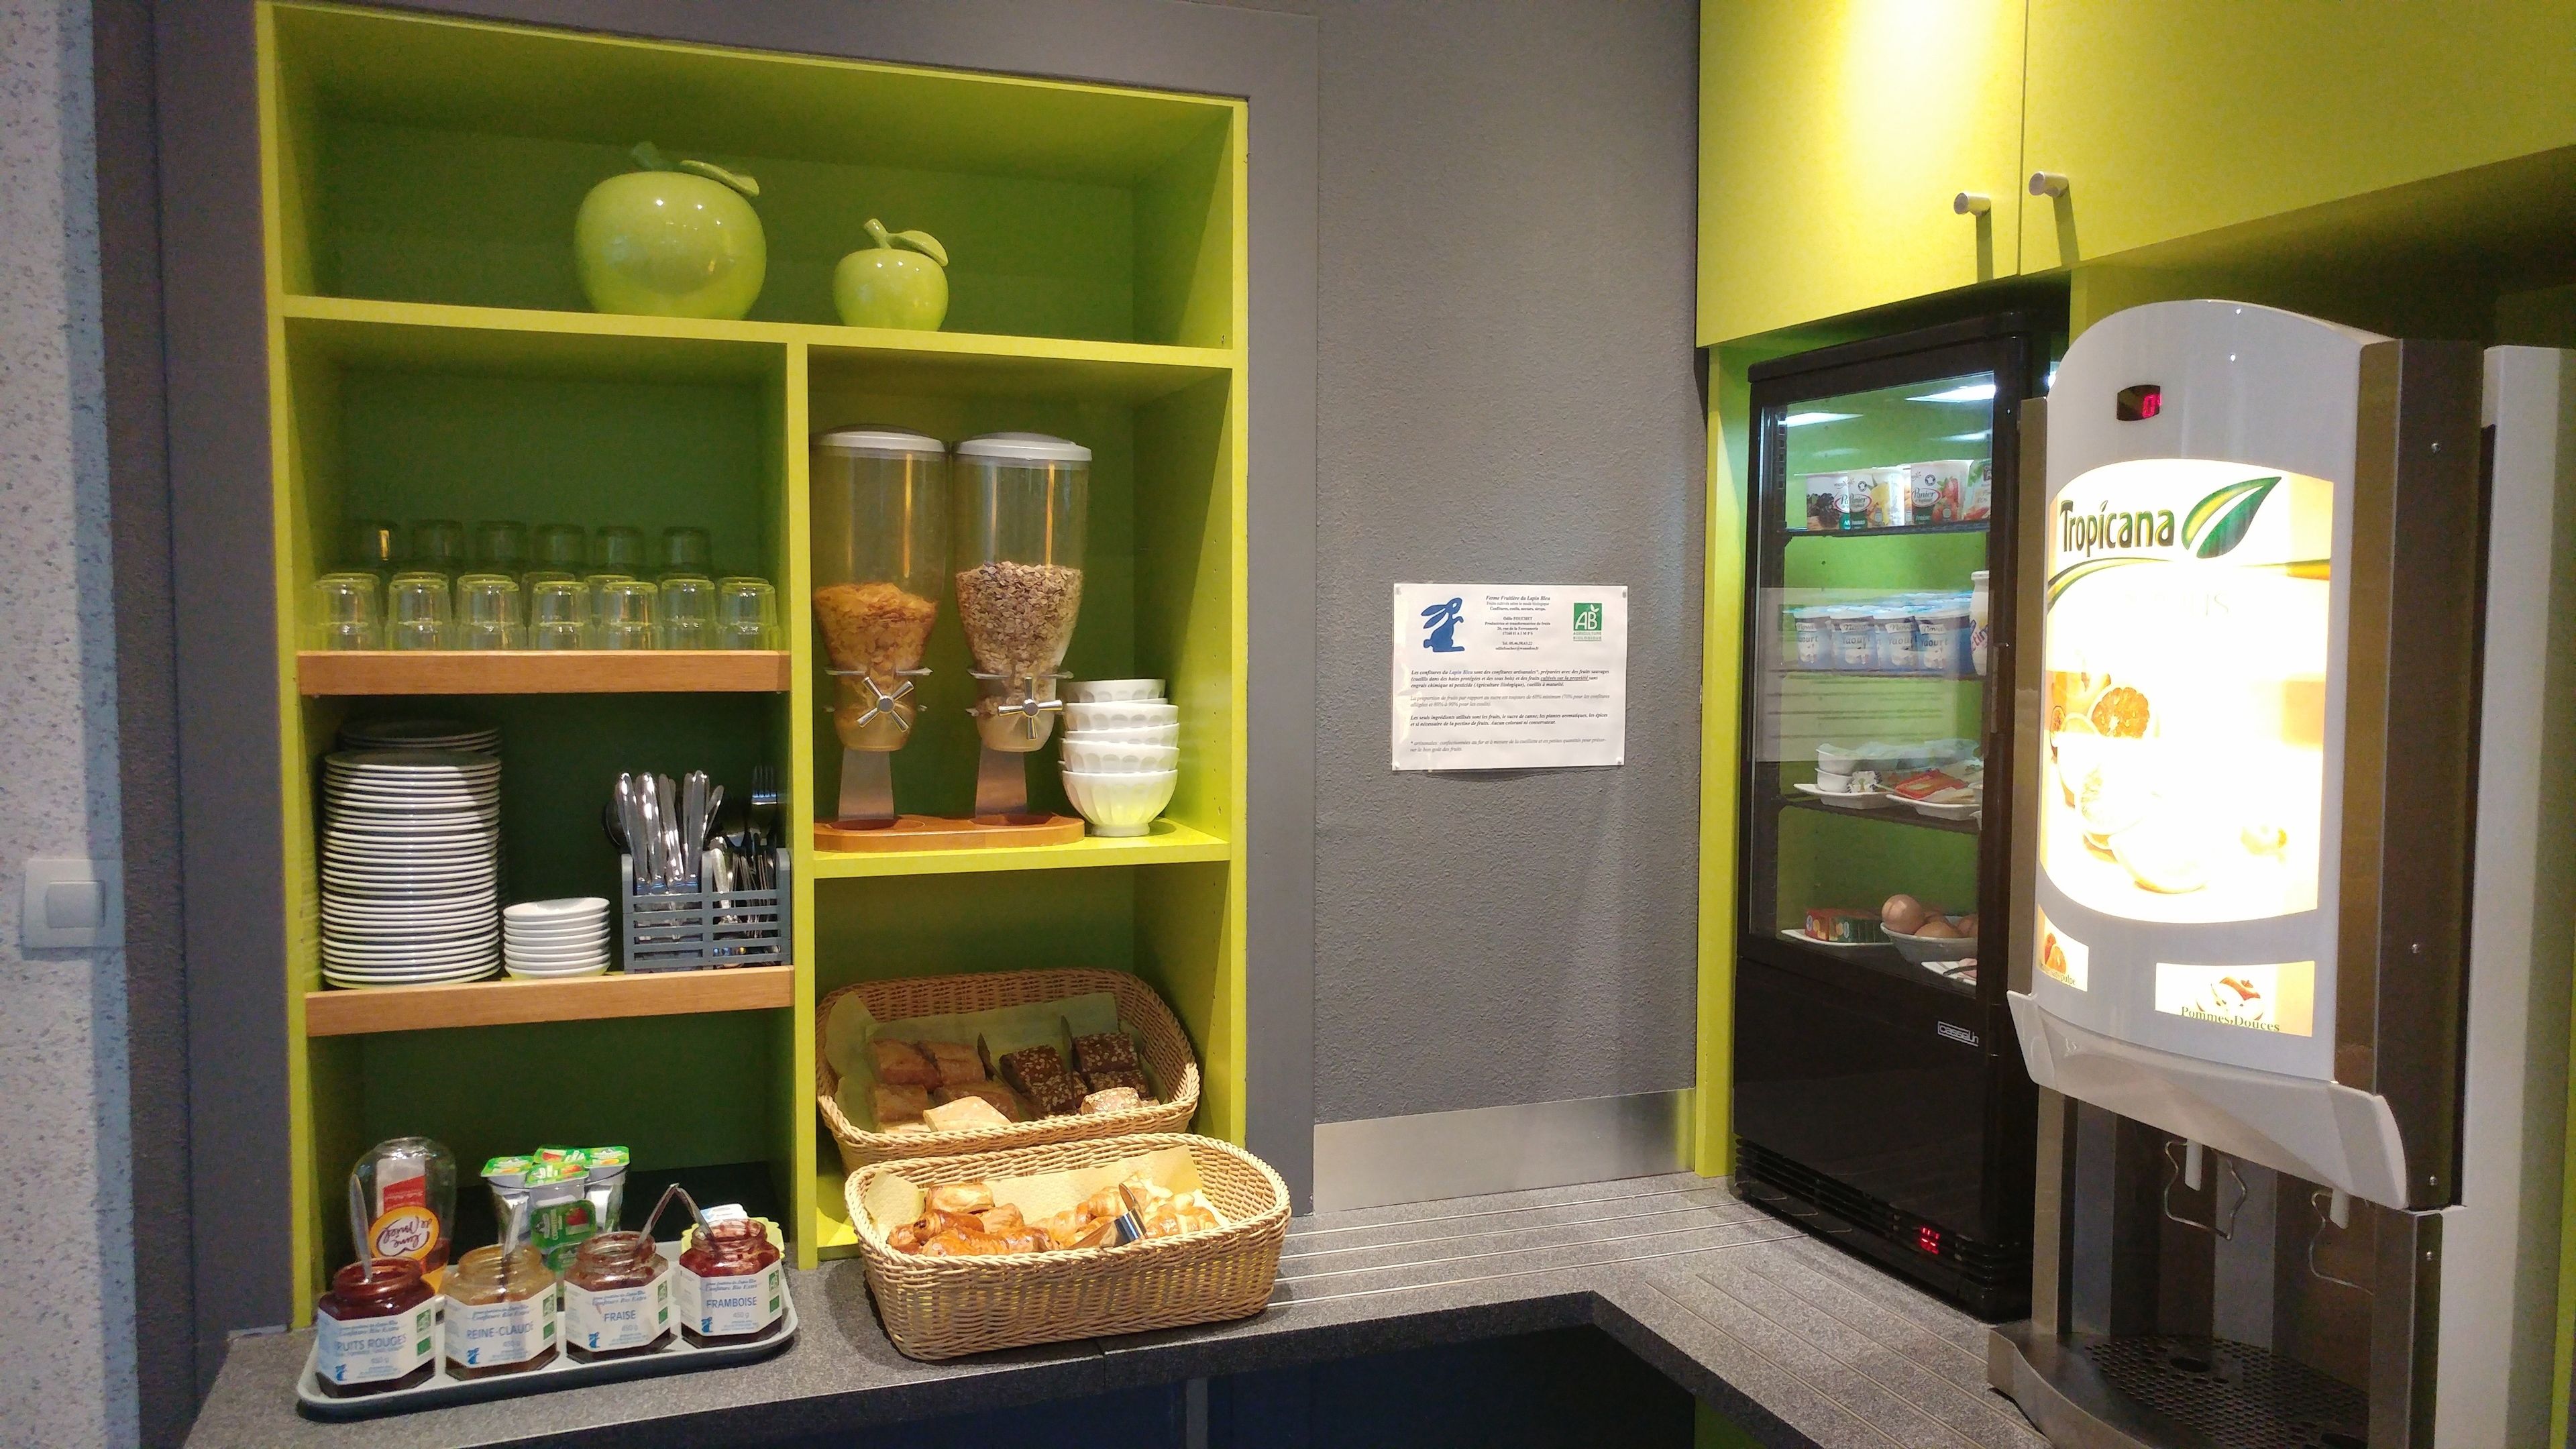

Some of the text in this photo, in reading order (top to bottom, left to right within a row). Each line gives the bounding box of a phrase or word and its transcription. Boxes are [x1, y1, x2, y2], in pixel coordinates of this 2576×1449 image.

[2060, 499, 2175, 557] Tropicana
[1574, 611, 1598, 630] AB
[2182, 1006, 2280, 1032] Pommes Douces
[706, 1296, 757, 1309] FRAMBOISE
[604, 1309, 637, 1322] FRAISE
[466, 1321, 534, 1340] REINE-CLAUDE
[368, 1333, 408, 1348] ROUGES
